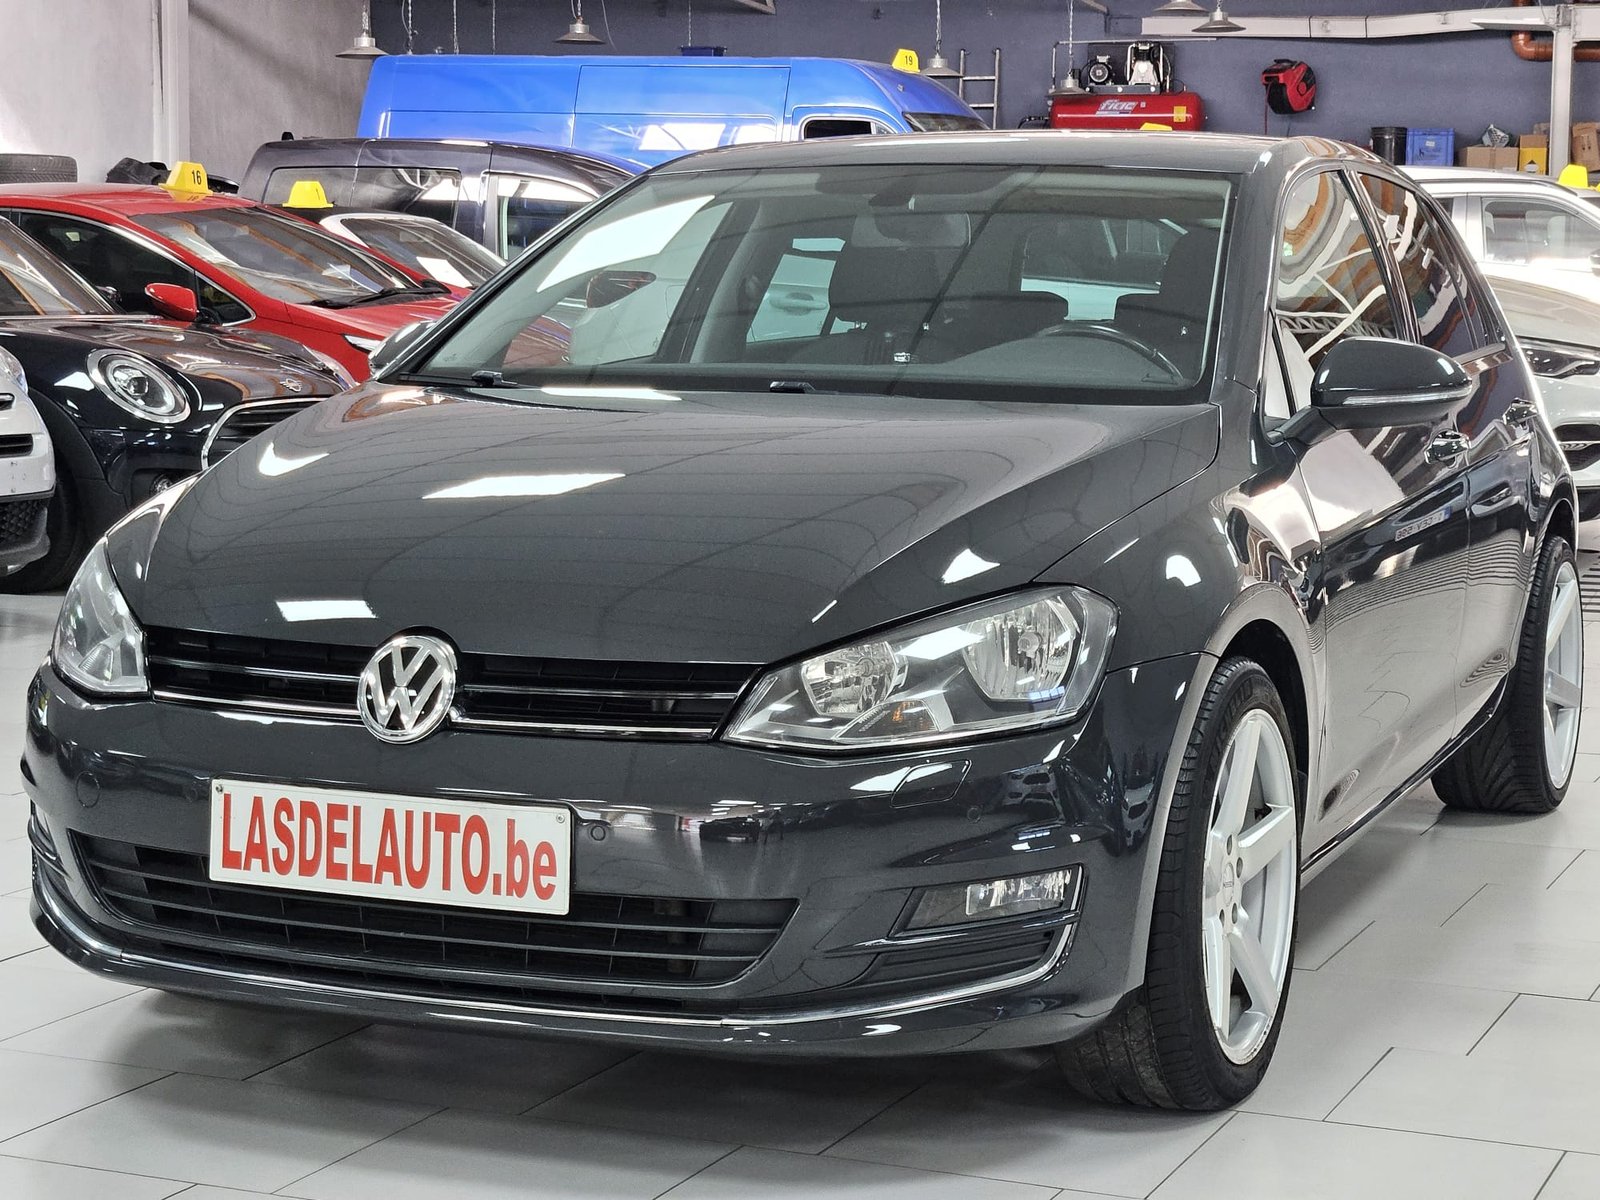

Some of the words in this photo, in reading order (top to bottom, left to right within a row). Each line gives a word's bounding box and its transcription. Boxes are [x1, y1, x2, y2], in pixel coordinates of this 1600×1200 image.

[905, 55, 914, 66] 19
[191, 169, 202, 185] 16
[222, 793, 557, 900] LASDELAUTO.be
